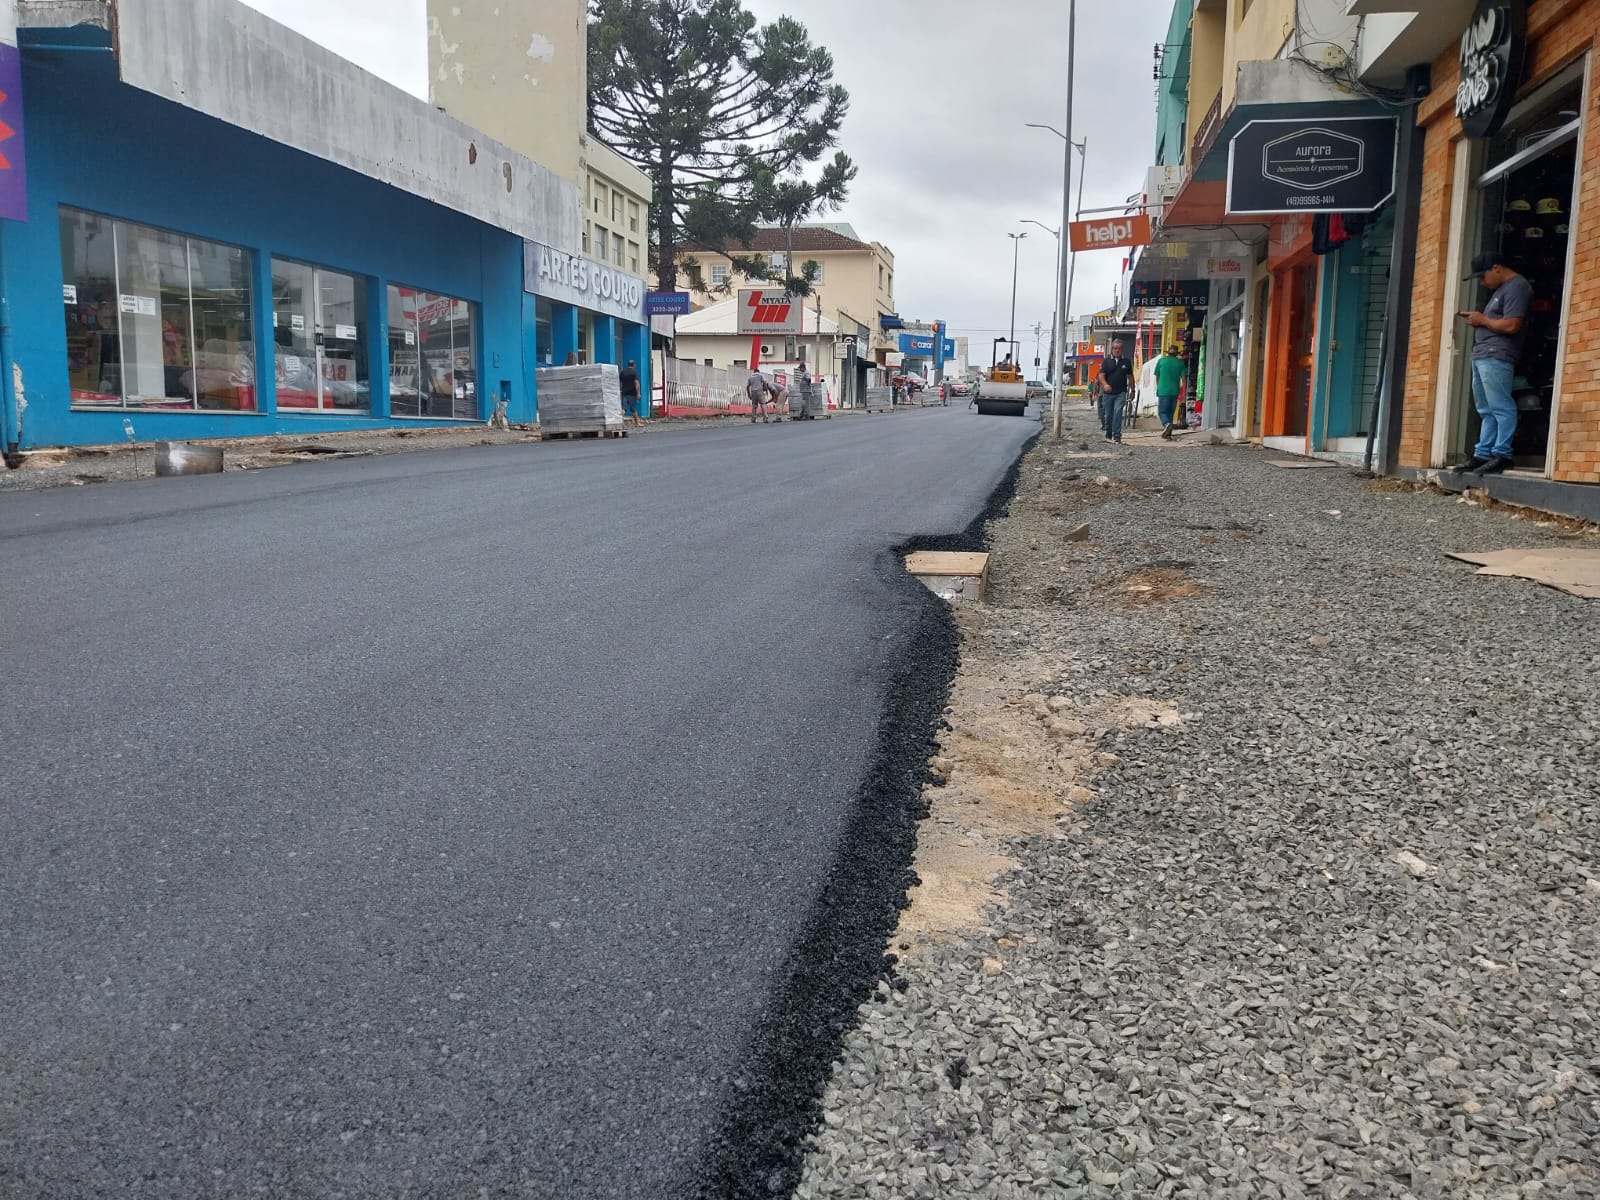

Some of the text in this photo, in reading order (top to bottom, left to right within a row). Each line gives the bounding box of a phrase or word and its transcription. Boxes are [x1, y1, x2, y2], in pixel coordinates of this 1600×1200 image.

[1086, 220, 1132, 244] help!
[540, 246, 640, 307] ARTES COURO
[762, 297, 791, 305] MYATA
[1133, 296, 1207, 306] PRESENTES
